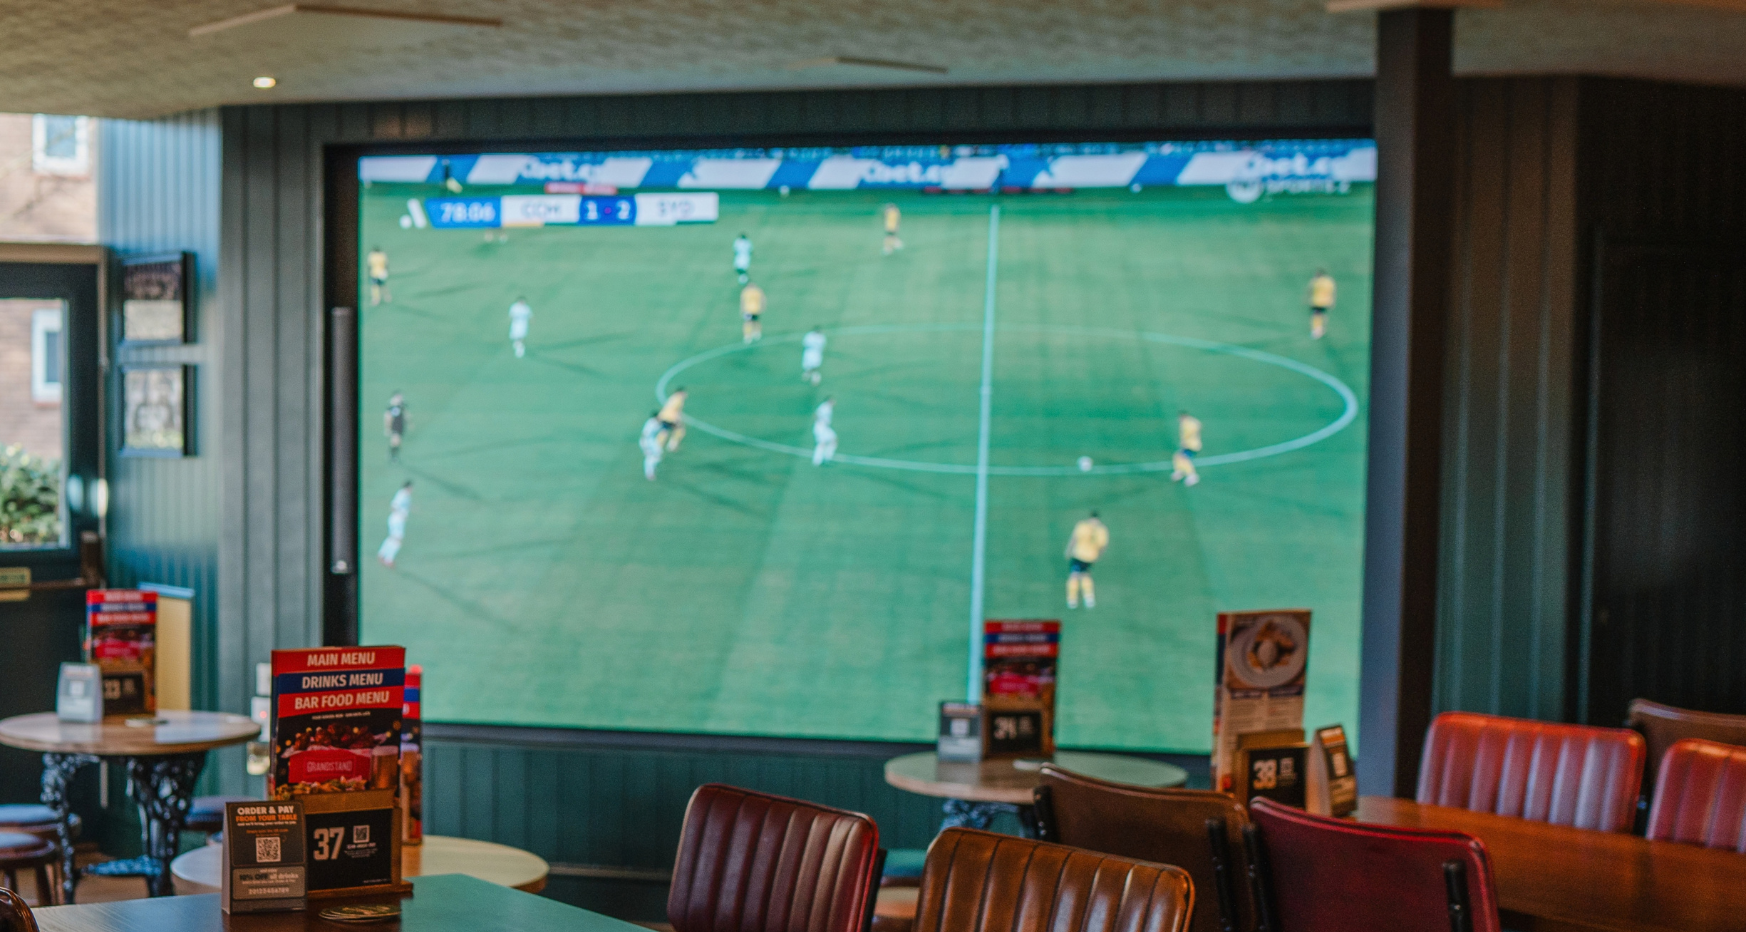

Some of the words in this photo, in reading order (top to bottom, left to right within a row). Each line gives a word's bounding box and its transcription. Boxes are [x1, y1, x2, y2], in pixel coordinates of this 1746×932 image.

[615, 200, 632, 220] 2
[306, 653, 338, 667] MAIN
[341, 651, 376, 665] MENU
[301, 674, 347, 689] DRINKS
[349, 672, 384, 687] MENU
[294, 697, 319, 710] BAR
[321, 694, 354, 708] FOOD
[356, 690, 390, 705] MENU
[1252, 758, 1278, 790] 38
[237, 806, 267, 815] ORDER
[277, 805, 294, 814] PAY
[277, 813, 298, 821] TABLE
[313, 826, 346, 860] 37
